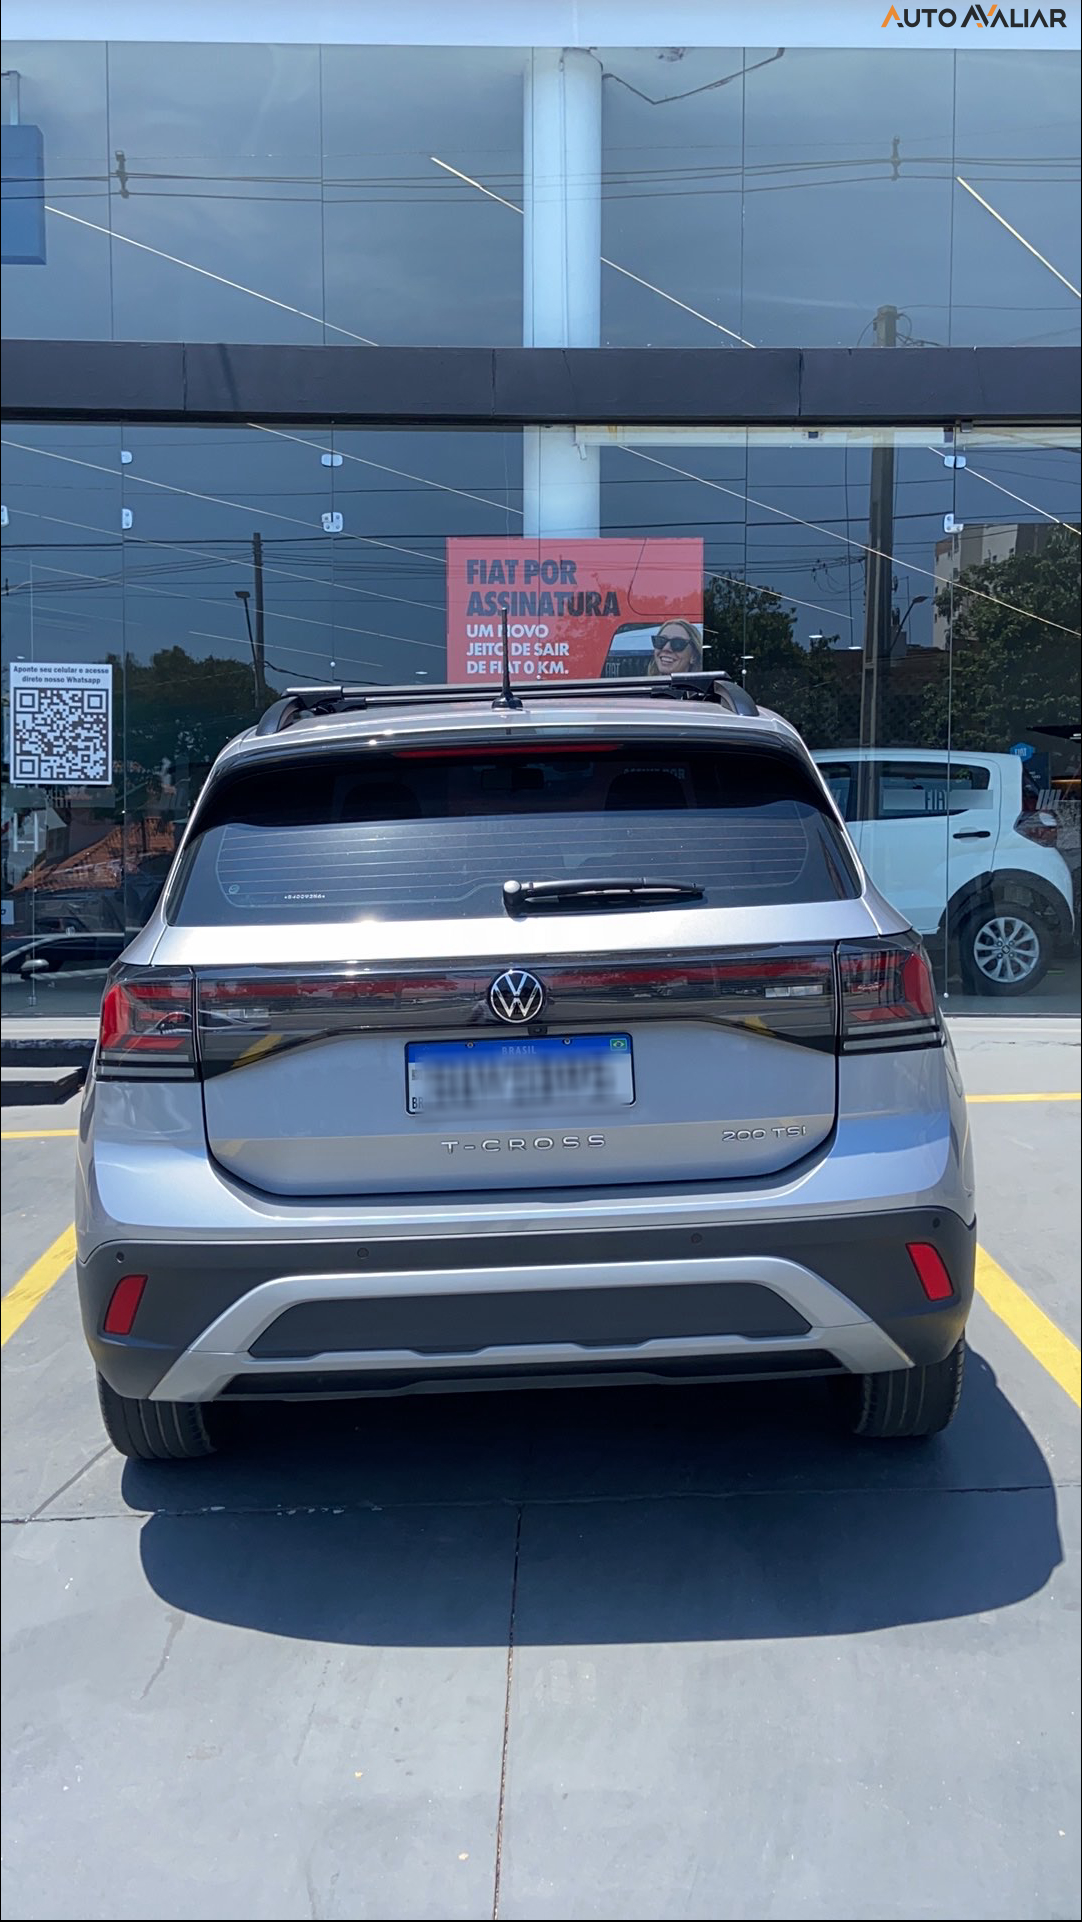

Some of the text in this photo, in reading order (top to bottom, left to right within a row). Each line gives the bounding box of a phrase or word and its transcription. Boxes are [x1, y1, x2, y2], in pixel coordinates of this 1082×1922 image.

[466, 559, 578, 585] FIAT POR
[466, 591, 621, 617] ASSINATURA
[466, 624, 493, 638] UM
[511, 642, 530, 656] DE
[534, 641, 570, 657] SAIR
[13, 665, 38, 674] Aponte
[53, 666, 77, 674] celular
[466, 660, 486, 675] DE
[537, 660, 569, 675] KM.
[66, 676, 101, 685] Whatsapp
[501, 1045, 537, 1055] BRASIL
[722, 1124, 807, 1141] 200 TSI
[441, 1134, 606, 1154] T-CROSS
